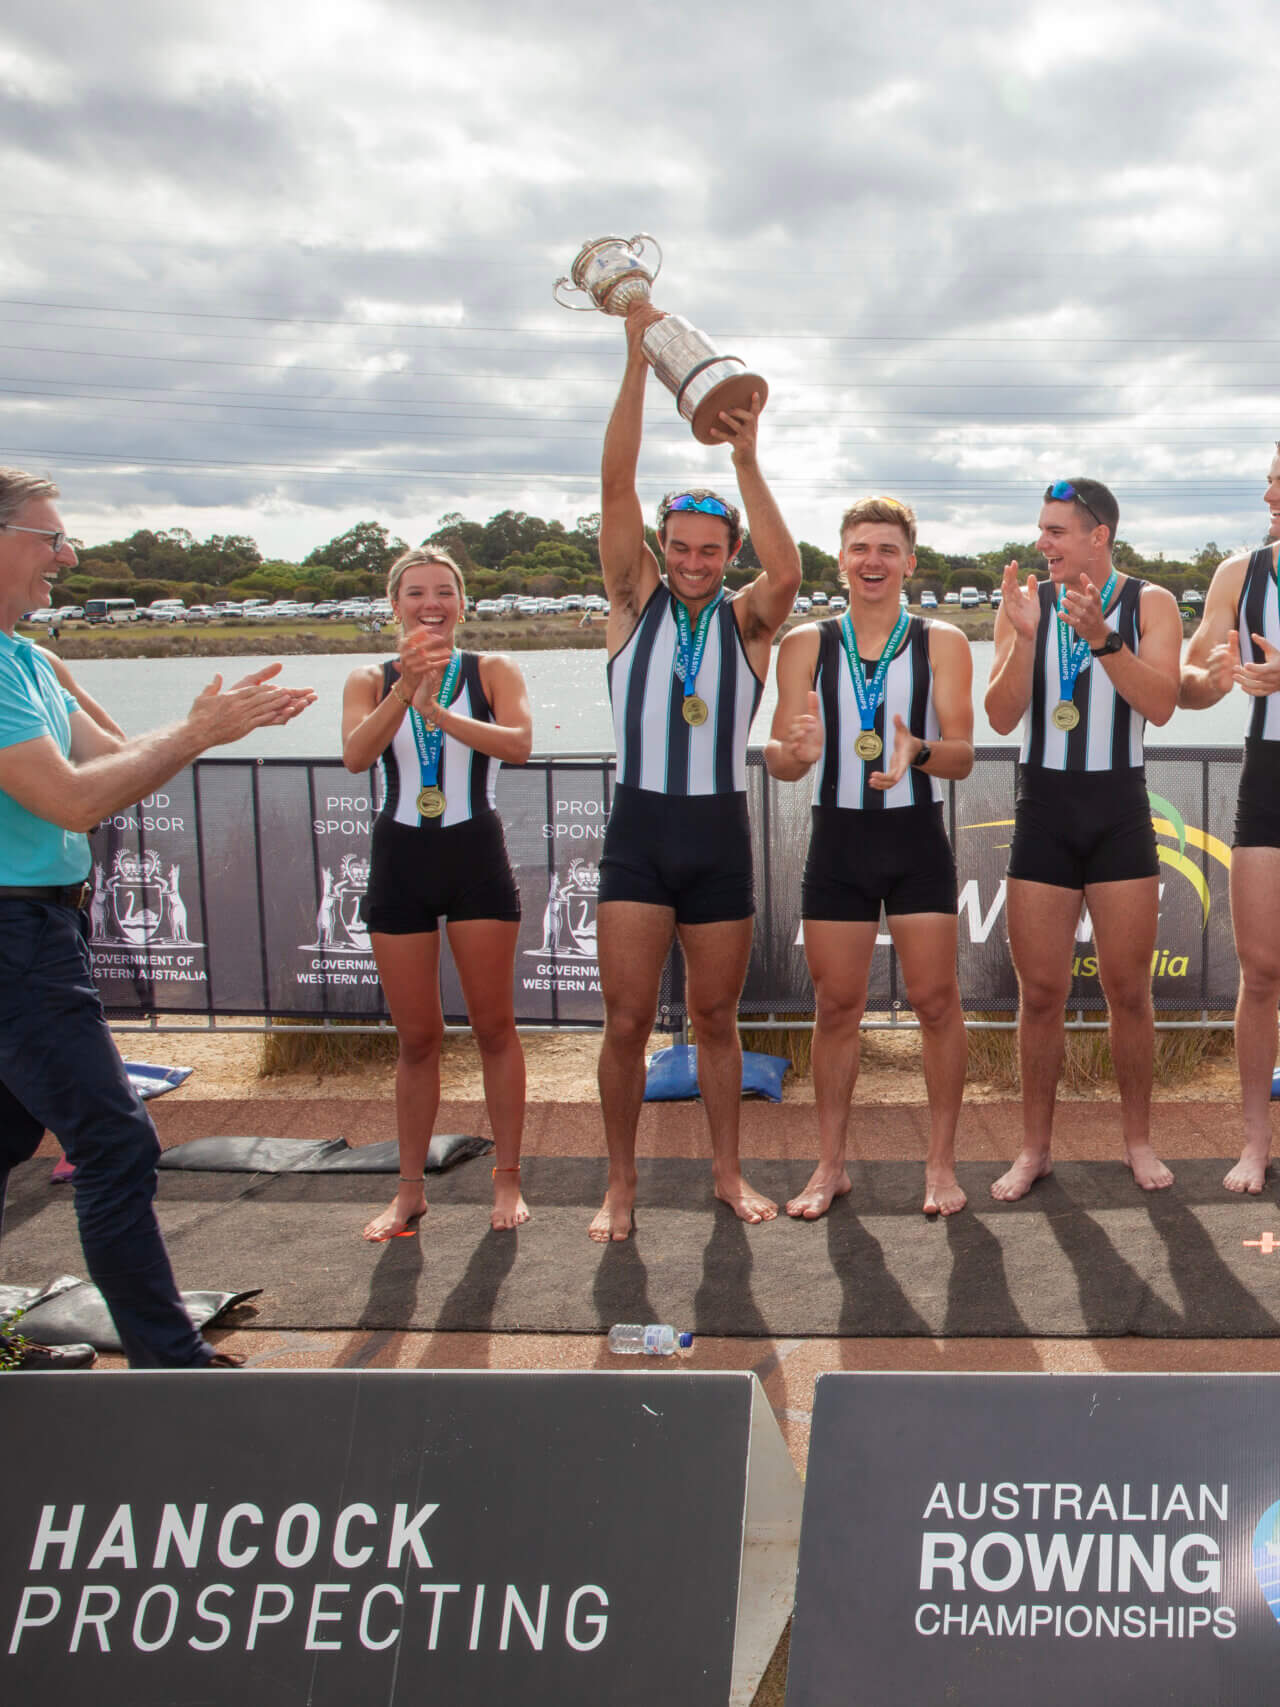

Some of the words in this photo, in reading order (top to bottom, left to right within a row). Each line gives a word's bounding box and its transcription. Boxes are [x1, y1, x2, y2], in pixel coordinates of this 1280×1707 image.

[690, 629, 705, 676] AUSTRALIAN
[327, 797, 384, 811] PROU
[556, 800, 613, 815] PROU
[101, 815, 184, 831] PONSOR
[313, 820, 370, 834] SPON
[542, 824, 607, 838] SPONS
[177, 955, 194, 966] OF
[93, 968, 135, 978] STERN
[139, 970, 207, 981] AUSTRALIA
[536, 964, 599, 977] GOVERNM
[297, 973, 358, 984] WESTERN
[523, 978, 585, 991] WESTERN
[922, 1482, 1229, 1521] AUSTRALIAN
[29, 1503, 439, 1570] HANCOCK
[919, 1532, 1222, 1596] ROWING
[8, 1583, 609, 1654] PROSPECTING
[914, 1603, 1237, 1639] CHAMPIONSHIPS
